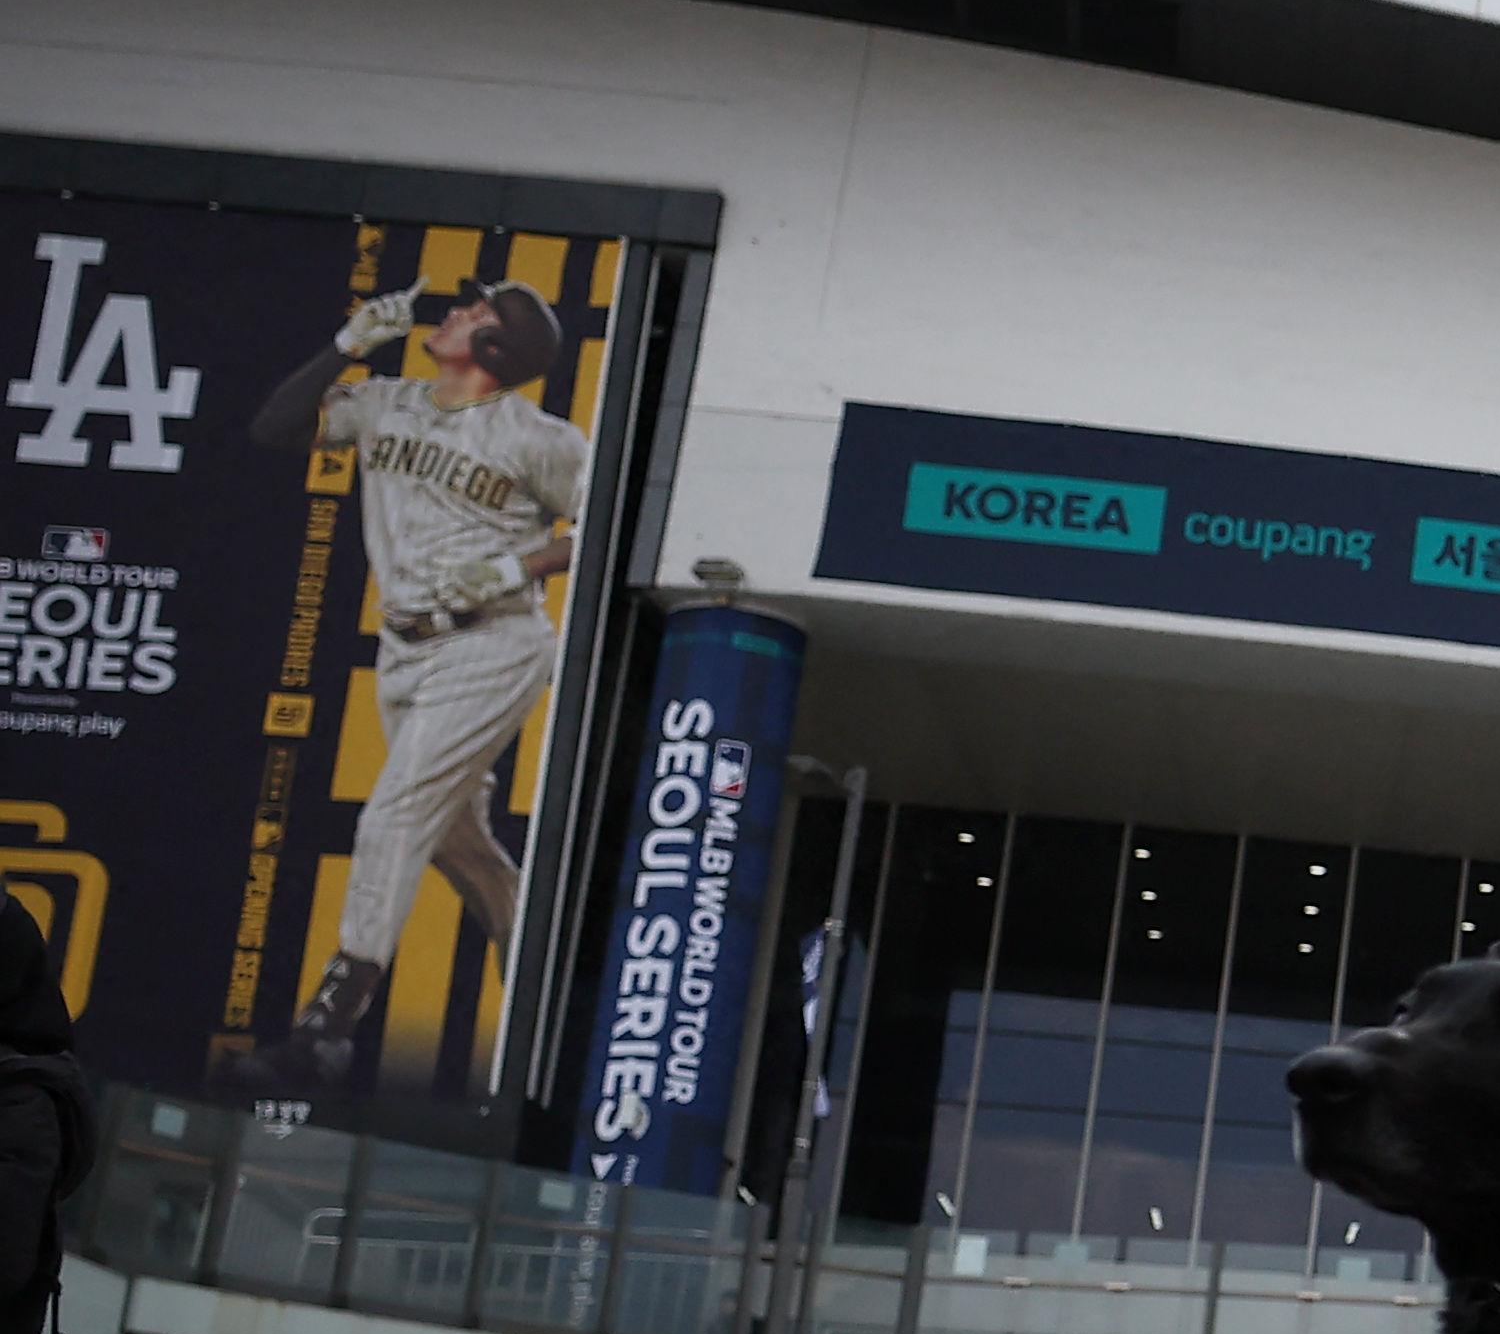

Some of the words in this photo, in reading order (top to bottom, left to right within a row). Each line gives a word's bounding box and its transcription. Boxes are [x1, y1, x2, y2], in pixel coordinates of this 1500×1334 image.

[6, 233, 200, 473] LA
[943, 481, 1130, 536] KOREA
[1184, 512, 1376, 571] coupang
[17, 560, 113, 586] WORLD
[112, 566, 180, 590] TOUR
[78, 711, 127, 739] play
[633, 698, 715, 908] SEOUL
[700, 797, 742, 874] MLB
[679, 875, 731, 1007] WORLD
[595, 914, 681, 1142] SERIES
[661, 1008, 709, 1105] TOUR
